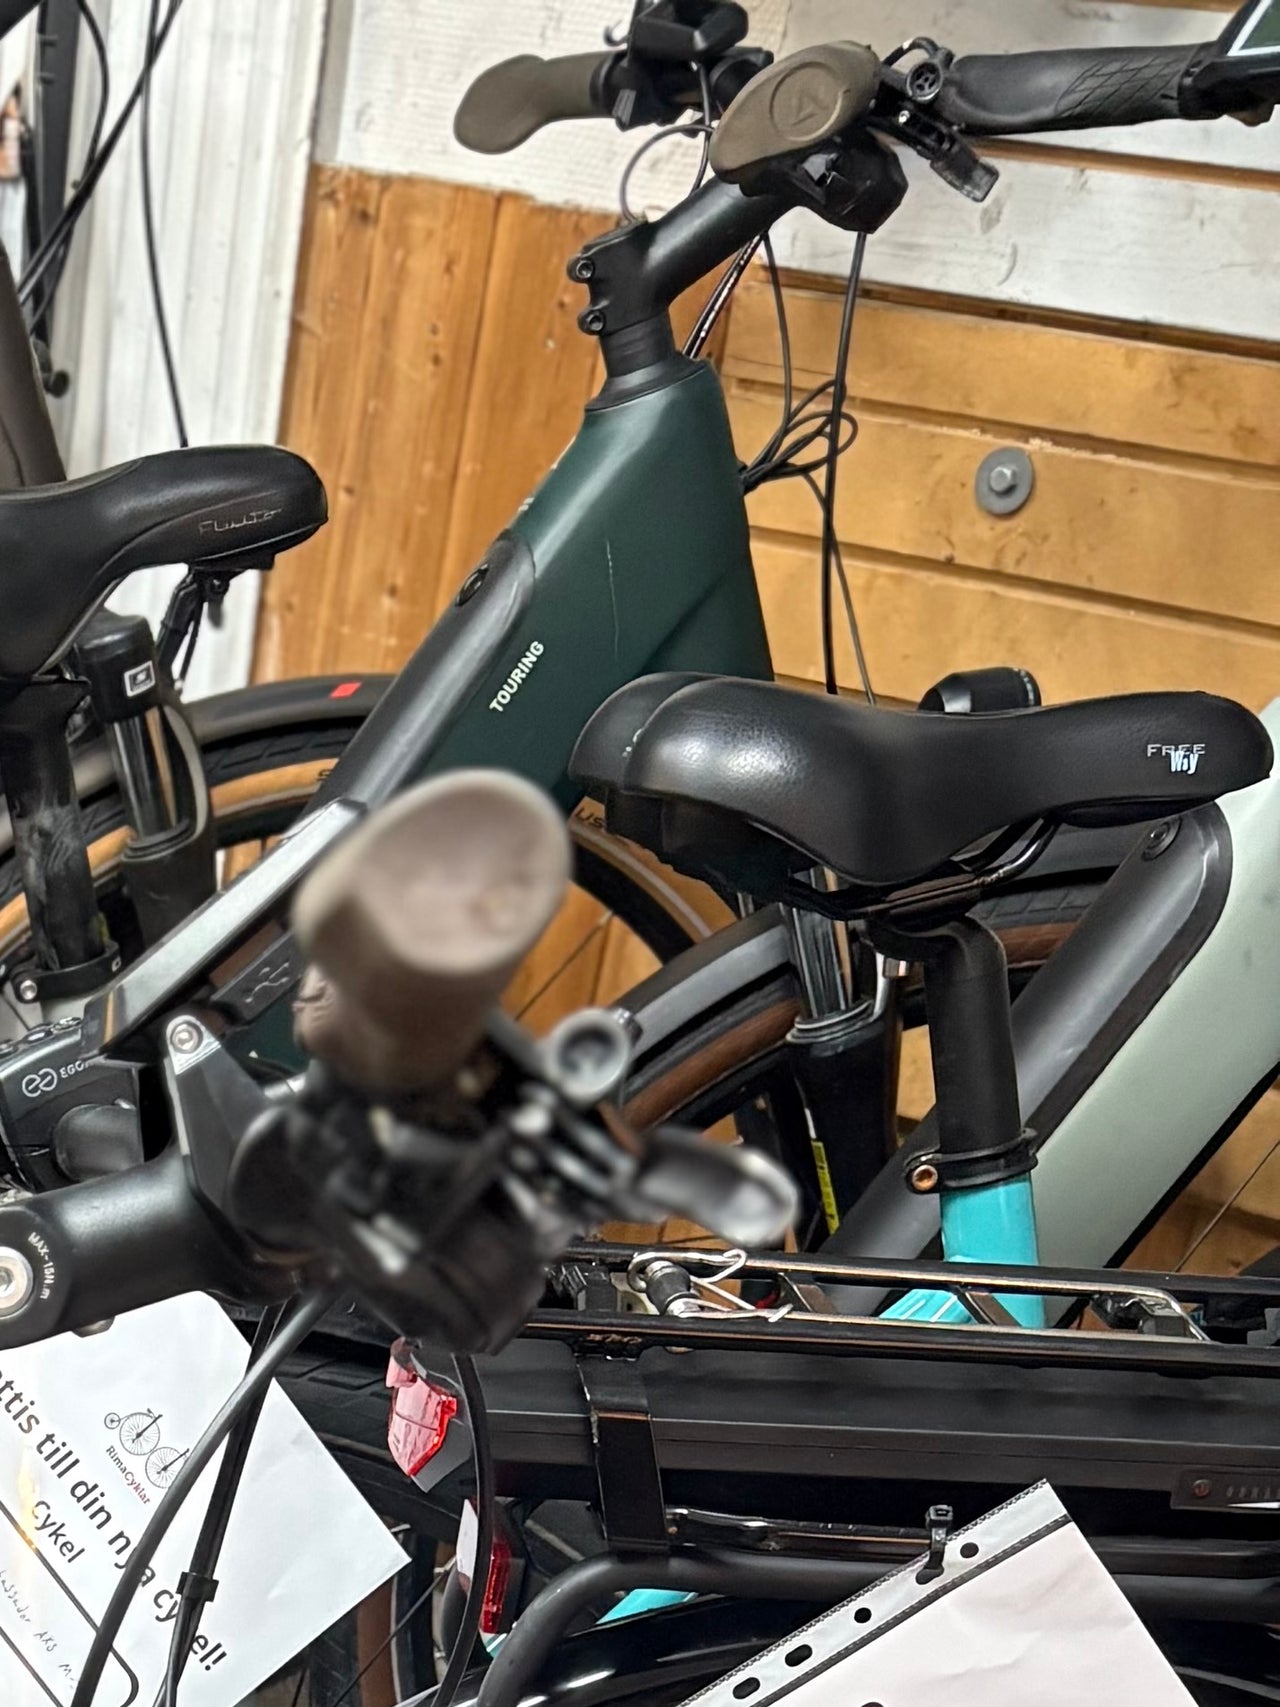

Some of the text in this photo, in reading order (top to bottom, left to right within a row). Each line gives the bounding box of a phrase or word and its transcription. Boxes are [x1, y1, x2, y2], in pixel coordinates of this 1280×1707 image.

[489, 640, 544, 712] TOURING
[1147, 743, 1206, 757] FREE
[31, 1499, 86, 1564] Cykel
[36, 1432, 81, 1479] till
[70, 1479, 113, 1530] din
[153, 1588, 229, 1672] cyel!
